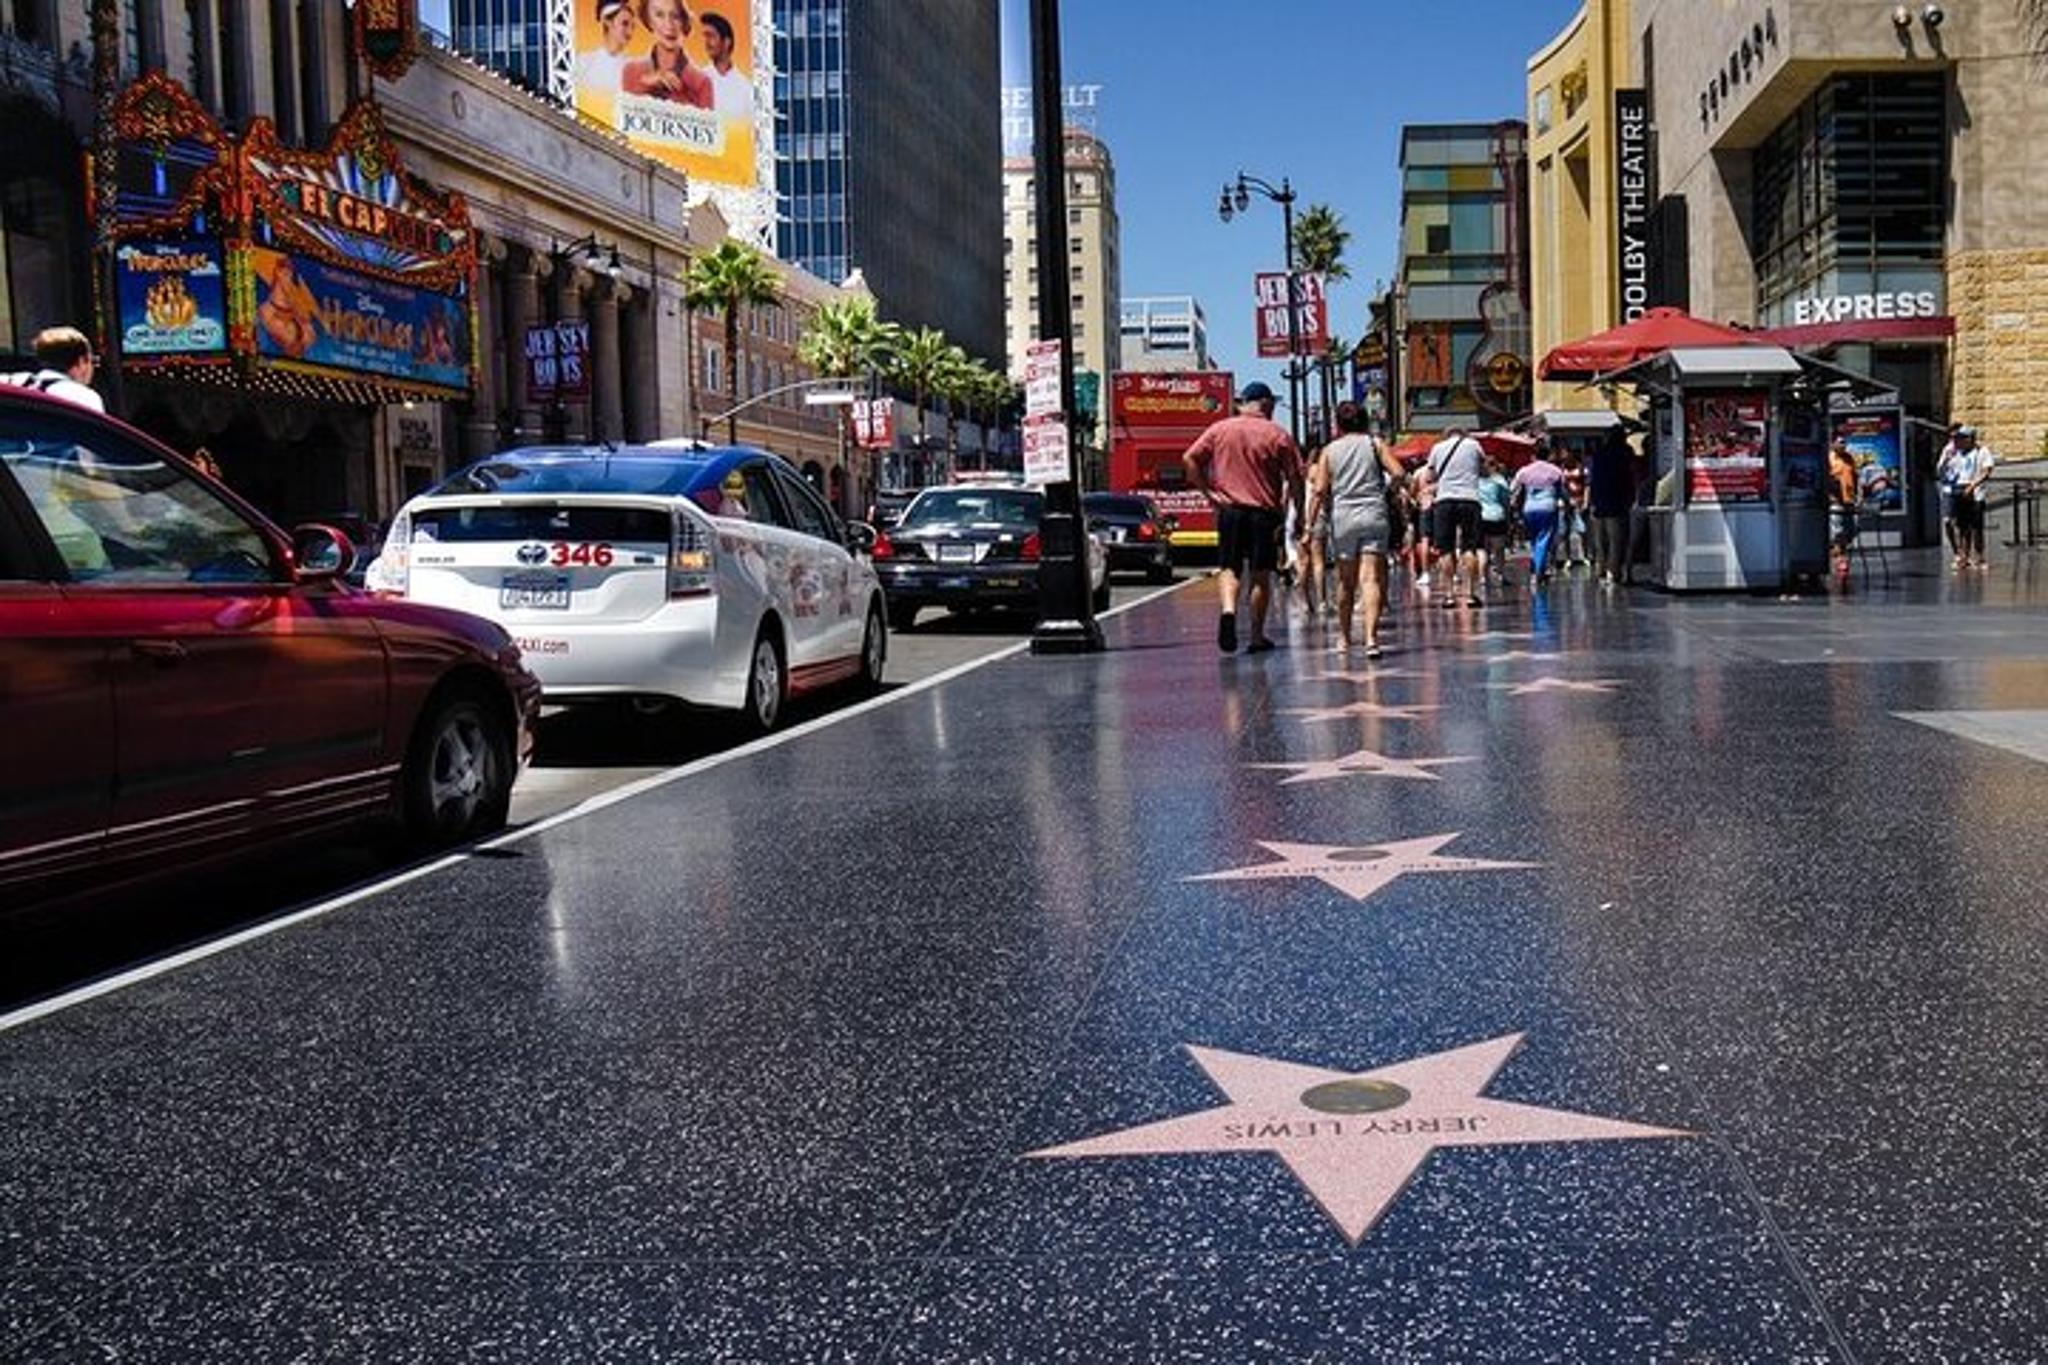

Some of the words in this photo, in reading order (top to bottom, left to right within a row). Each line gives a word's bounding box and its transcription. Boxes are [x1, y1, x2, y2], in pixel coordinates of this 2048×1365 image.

[623, 113, 717, 144] JOURNEY
[1621, 107, 1645, 227] THEATRE
[301, 183, 330, 217] EL
[1624, 235, 1647, 324] DOLBY
[1794, 291, 1936, 325] EXPRESS
[550, 543, 614, 566] 346
[1224, 1117, 1341, 1139] LEWIS
[1362, 1114, 1488, 1136] JERRY
